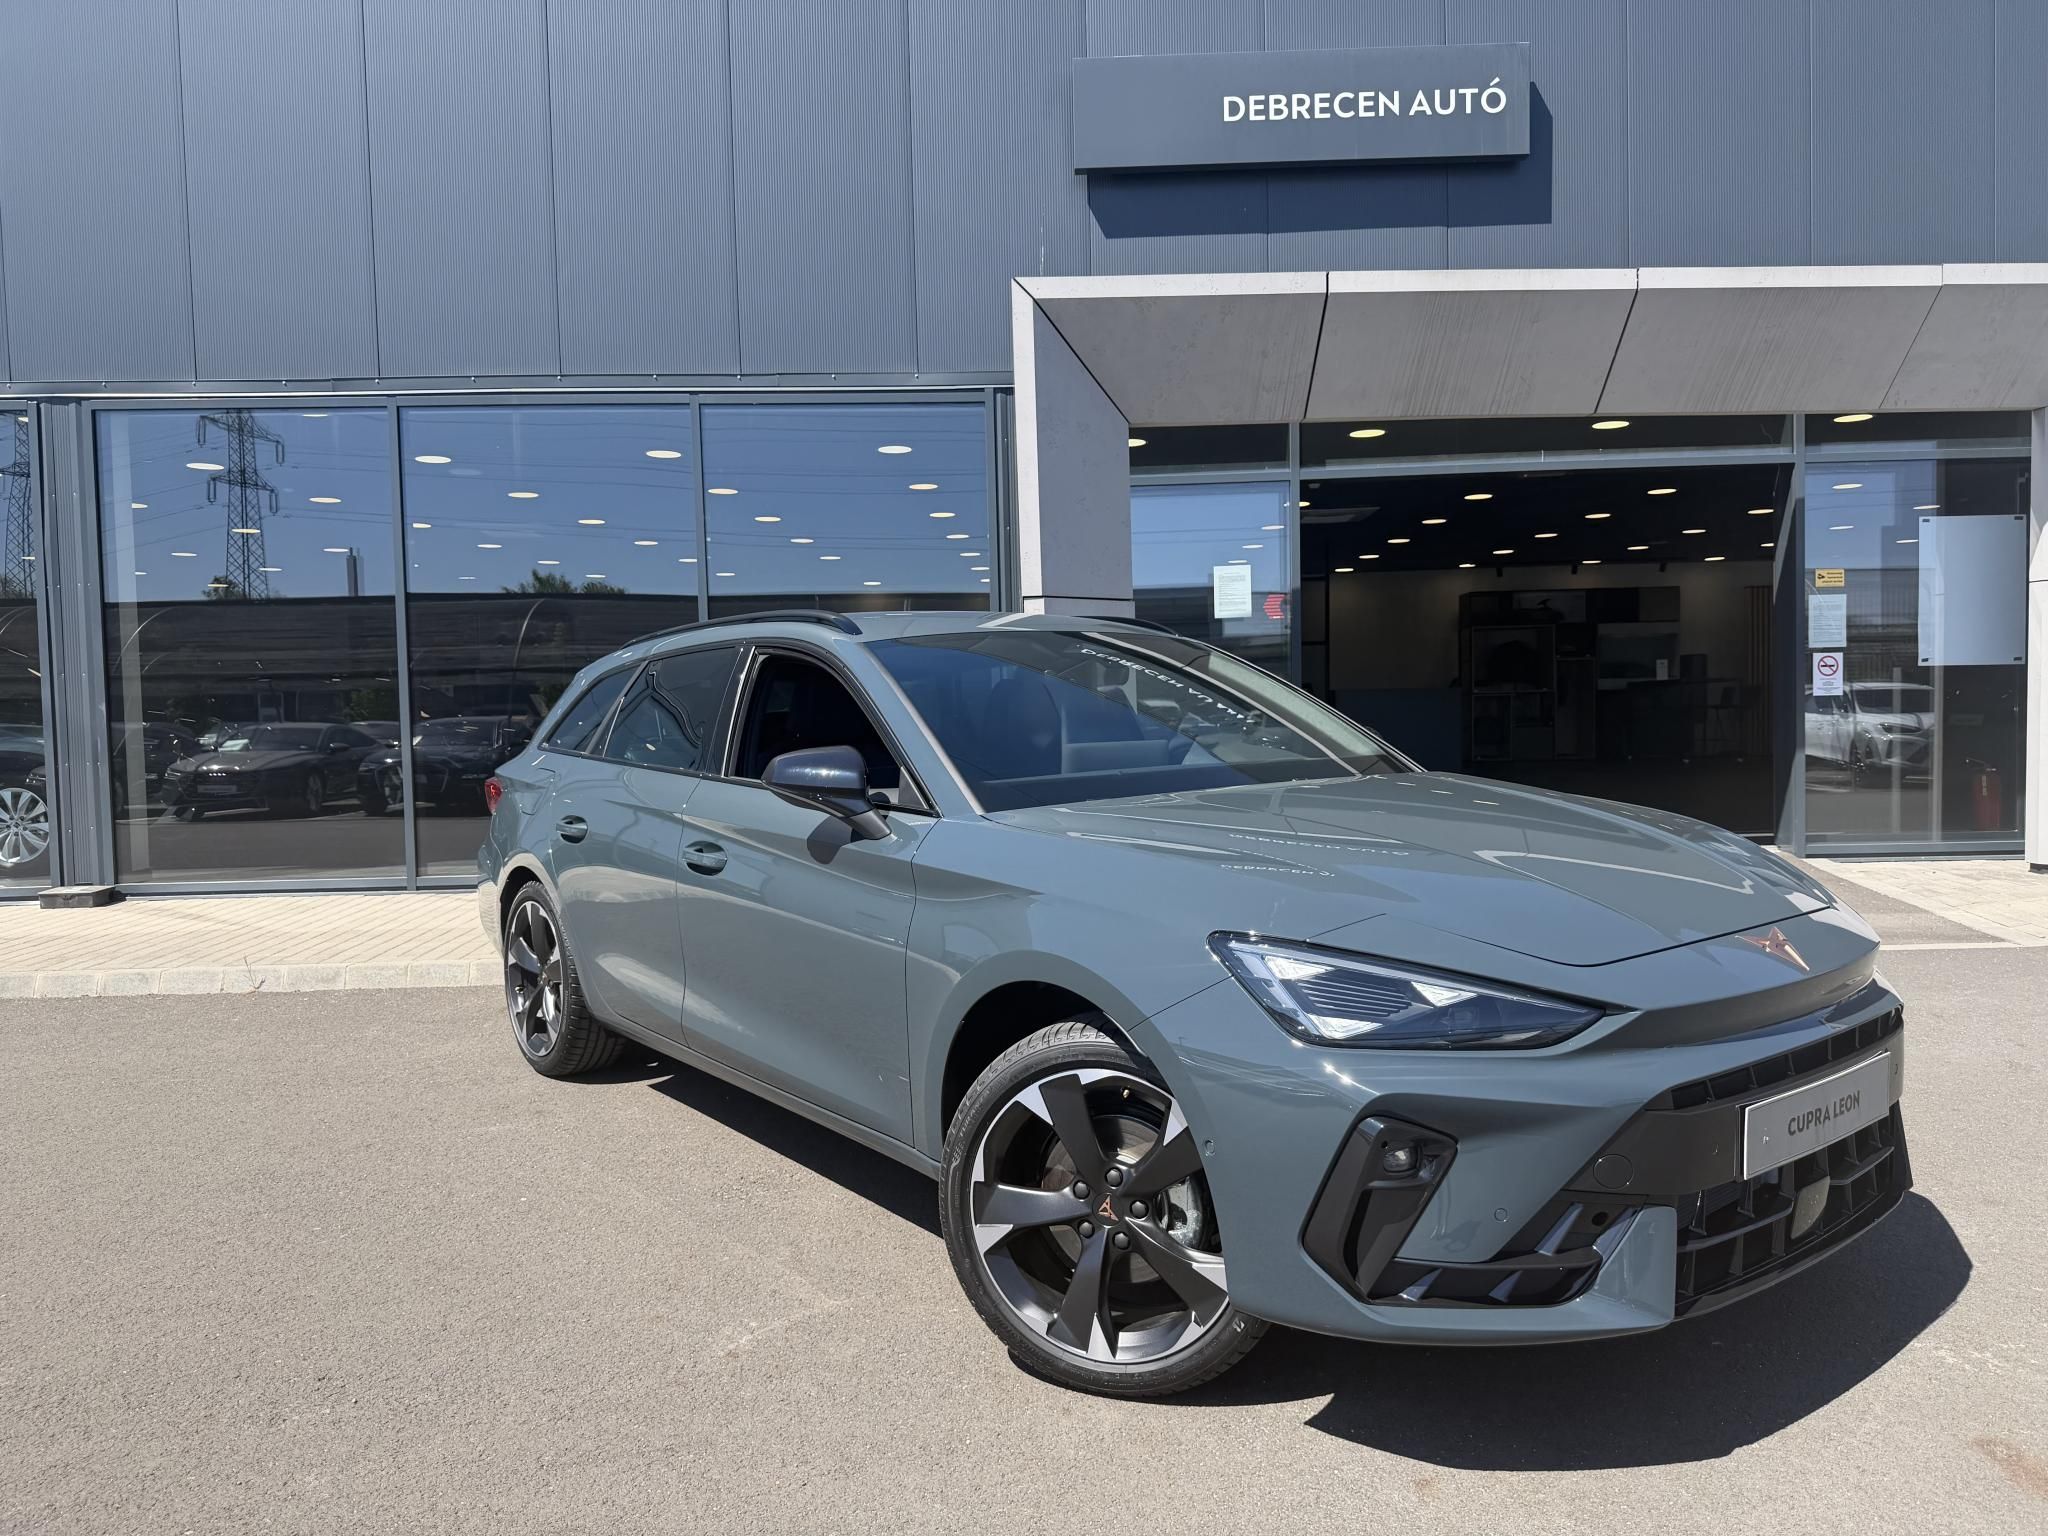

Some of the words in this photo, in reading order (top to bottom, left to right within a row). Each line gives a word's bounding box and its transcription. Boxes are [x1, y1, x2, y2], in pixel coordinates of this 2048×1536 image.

[1223, 89, 1400, 122] DEBRECEN
[1408, 76, 1507, 116] AUTÓ
[1787, 1105, 1831, 1136] CUPRA
[1832, 1089, 1860, 1119] LEON
